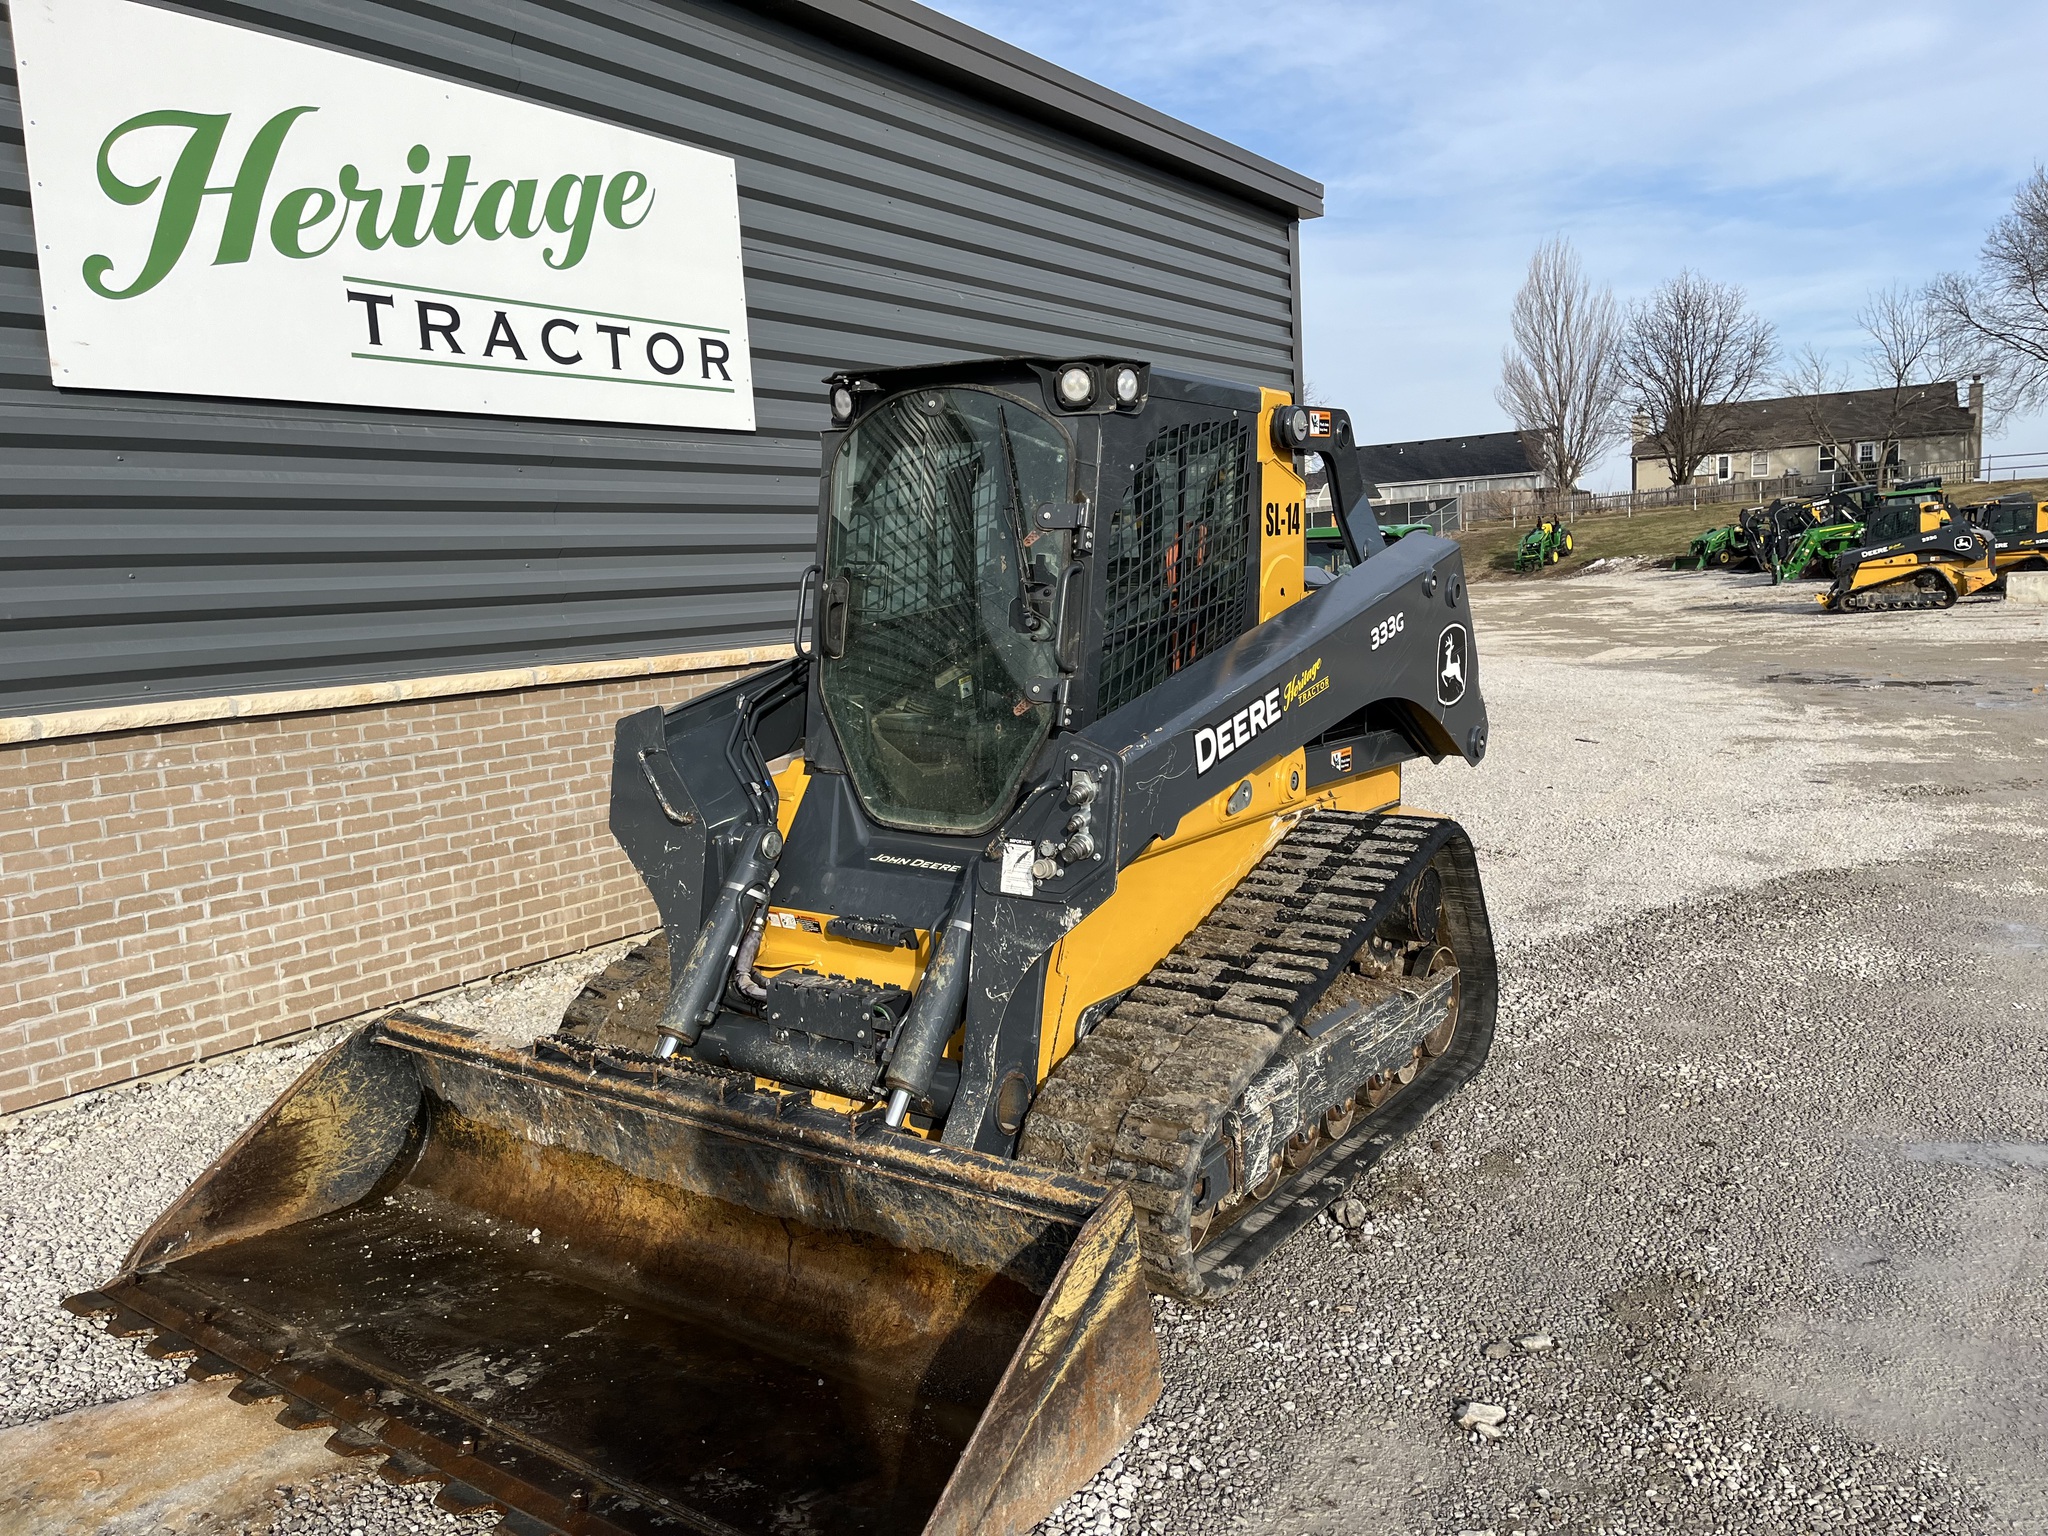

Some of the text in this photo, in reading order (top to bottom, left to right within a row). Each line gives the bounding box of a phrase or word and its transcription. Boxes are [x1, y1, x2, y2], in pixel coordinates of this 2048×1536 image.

[83, 106, 655, 300] Heritage
[346, 289, 733, 382] TRACTOR
[1265, 502, 1300, 537] SL-14
[1861, 546, 1889, 558] DEERE
[1370, 611, 1405, 651] 333G
[1283, 657, 1322, 712] Heritage
[1298, 677, 1330, 705] TRACTOR
[1194, 687, 1282, 774] DEERE
[869, 853, 962, 873] JOHN DEERE
